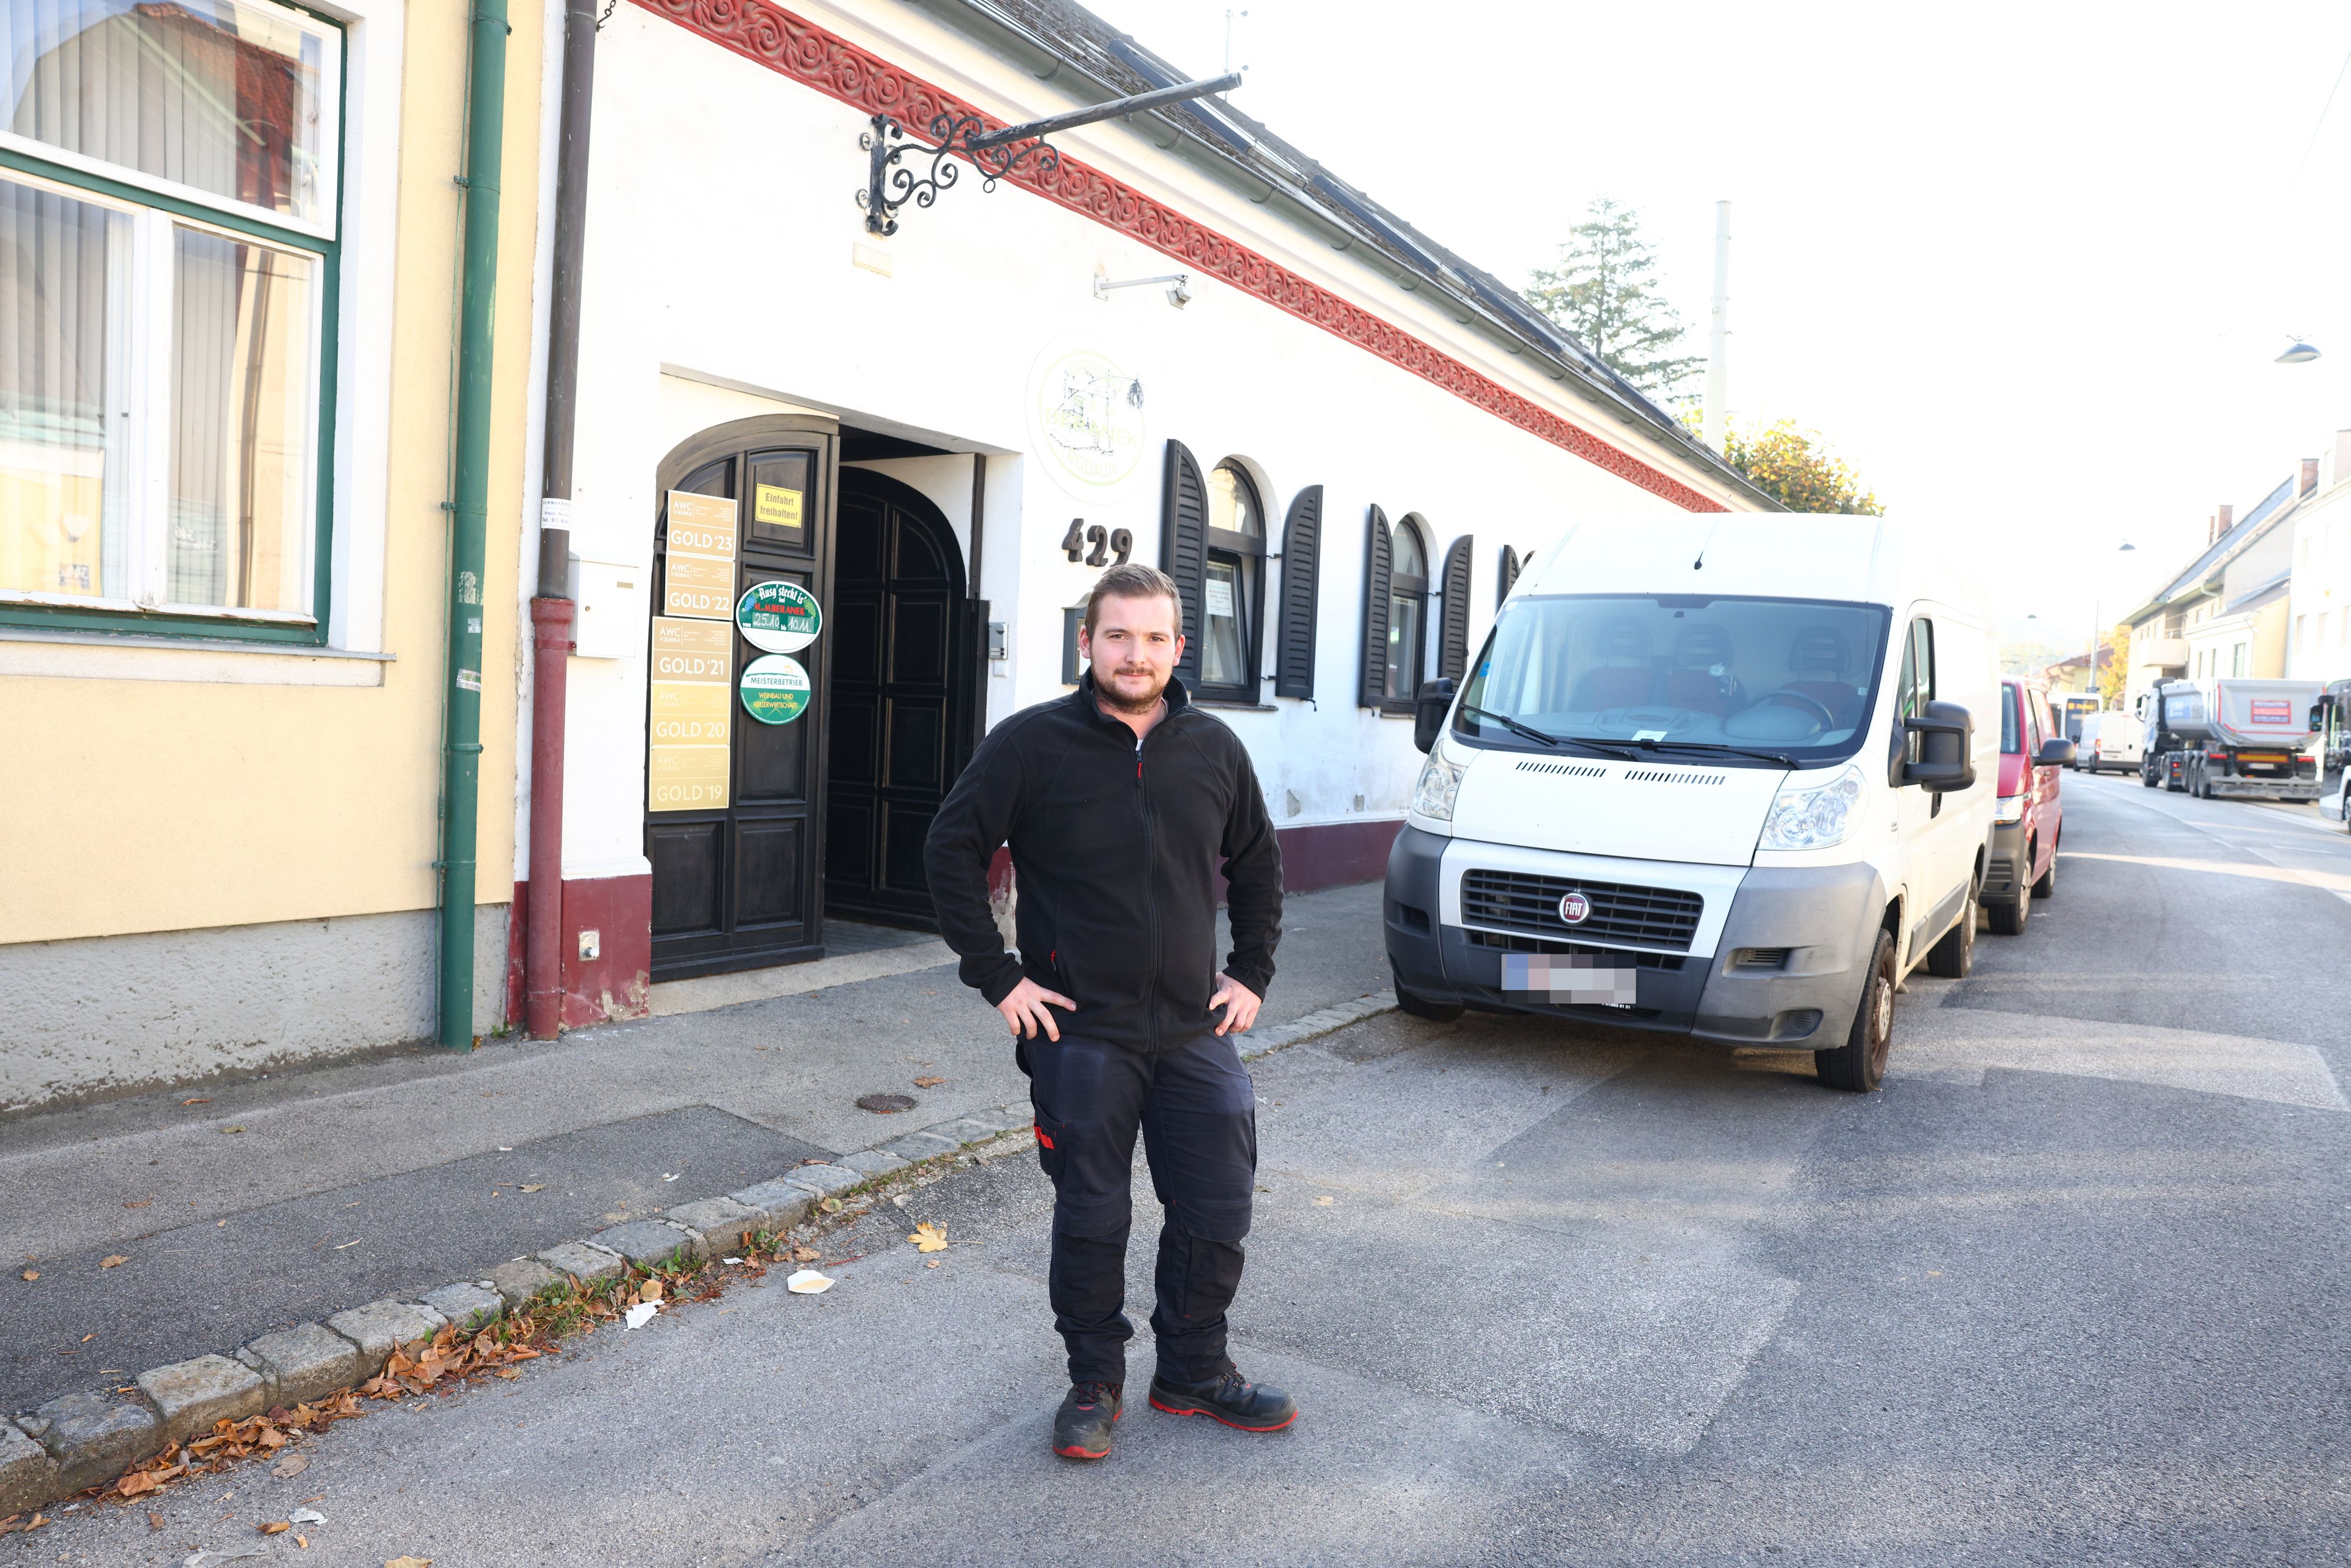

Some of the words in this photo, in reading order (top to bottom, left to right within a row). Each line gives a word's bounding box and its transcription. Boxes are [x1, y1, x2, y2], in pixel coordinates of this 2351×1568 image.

[1066, 448, 1117, 478] RODAUN
[673, 500, 693, 511] AWC
[765, 492, 794, 506] Einfahrt
[760, 505, 798, 520] freihalten!
[671, 530, 712, 548] GOLD
[1061, 518, 1133, 567] 429
[671, 563, 690, 572] AWC
[669, 592, 710, 609] GOLD
[659, 626, 681, 637] AWC
[659, 657, 705, 675] GOLD
[751, 677, 802, 686] MEISTERBETRIEB
[658, 691, 679, 701] AWC
[656, 721, 702, 738] GOLD
[658, 756, 678, 765] AWC
[657, 785, 702, 802] GOLD
[1565, 902, 1583, 916] FIAT
